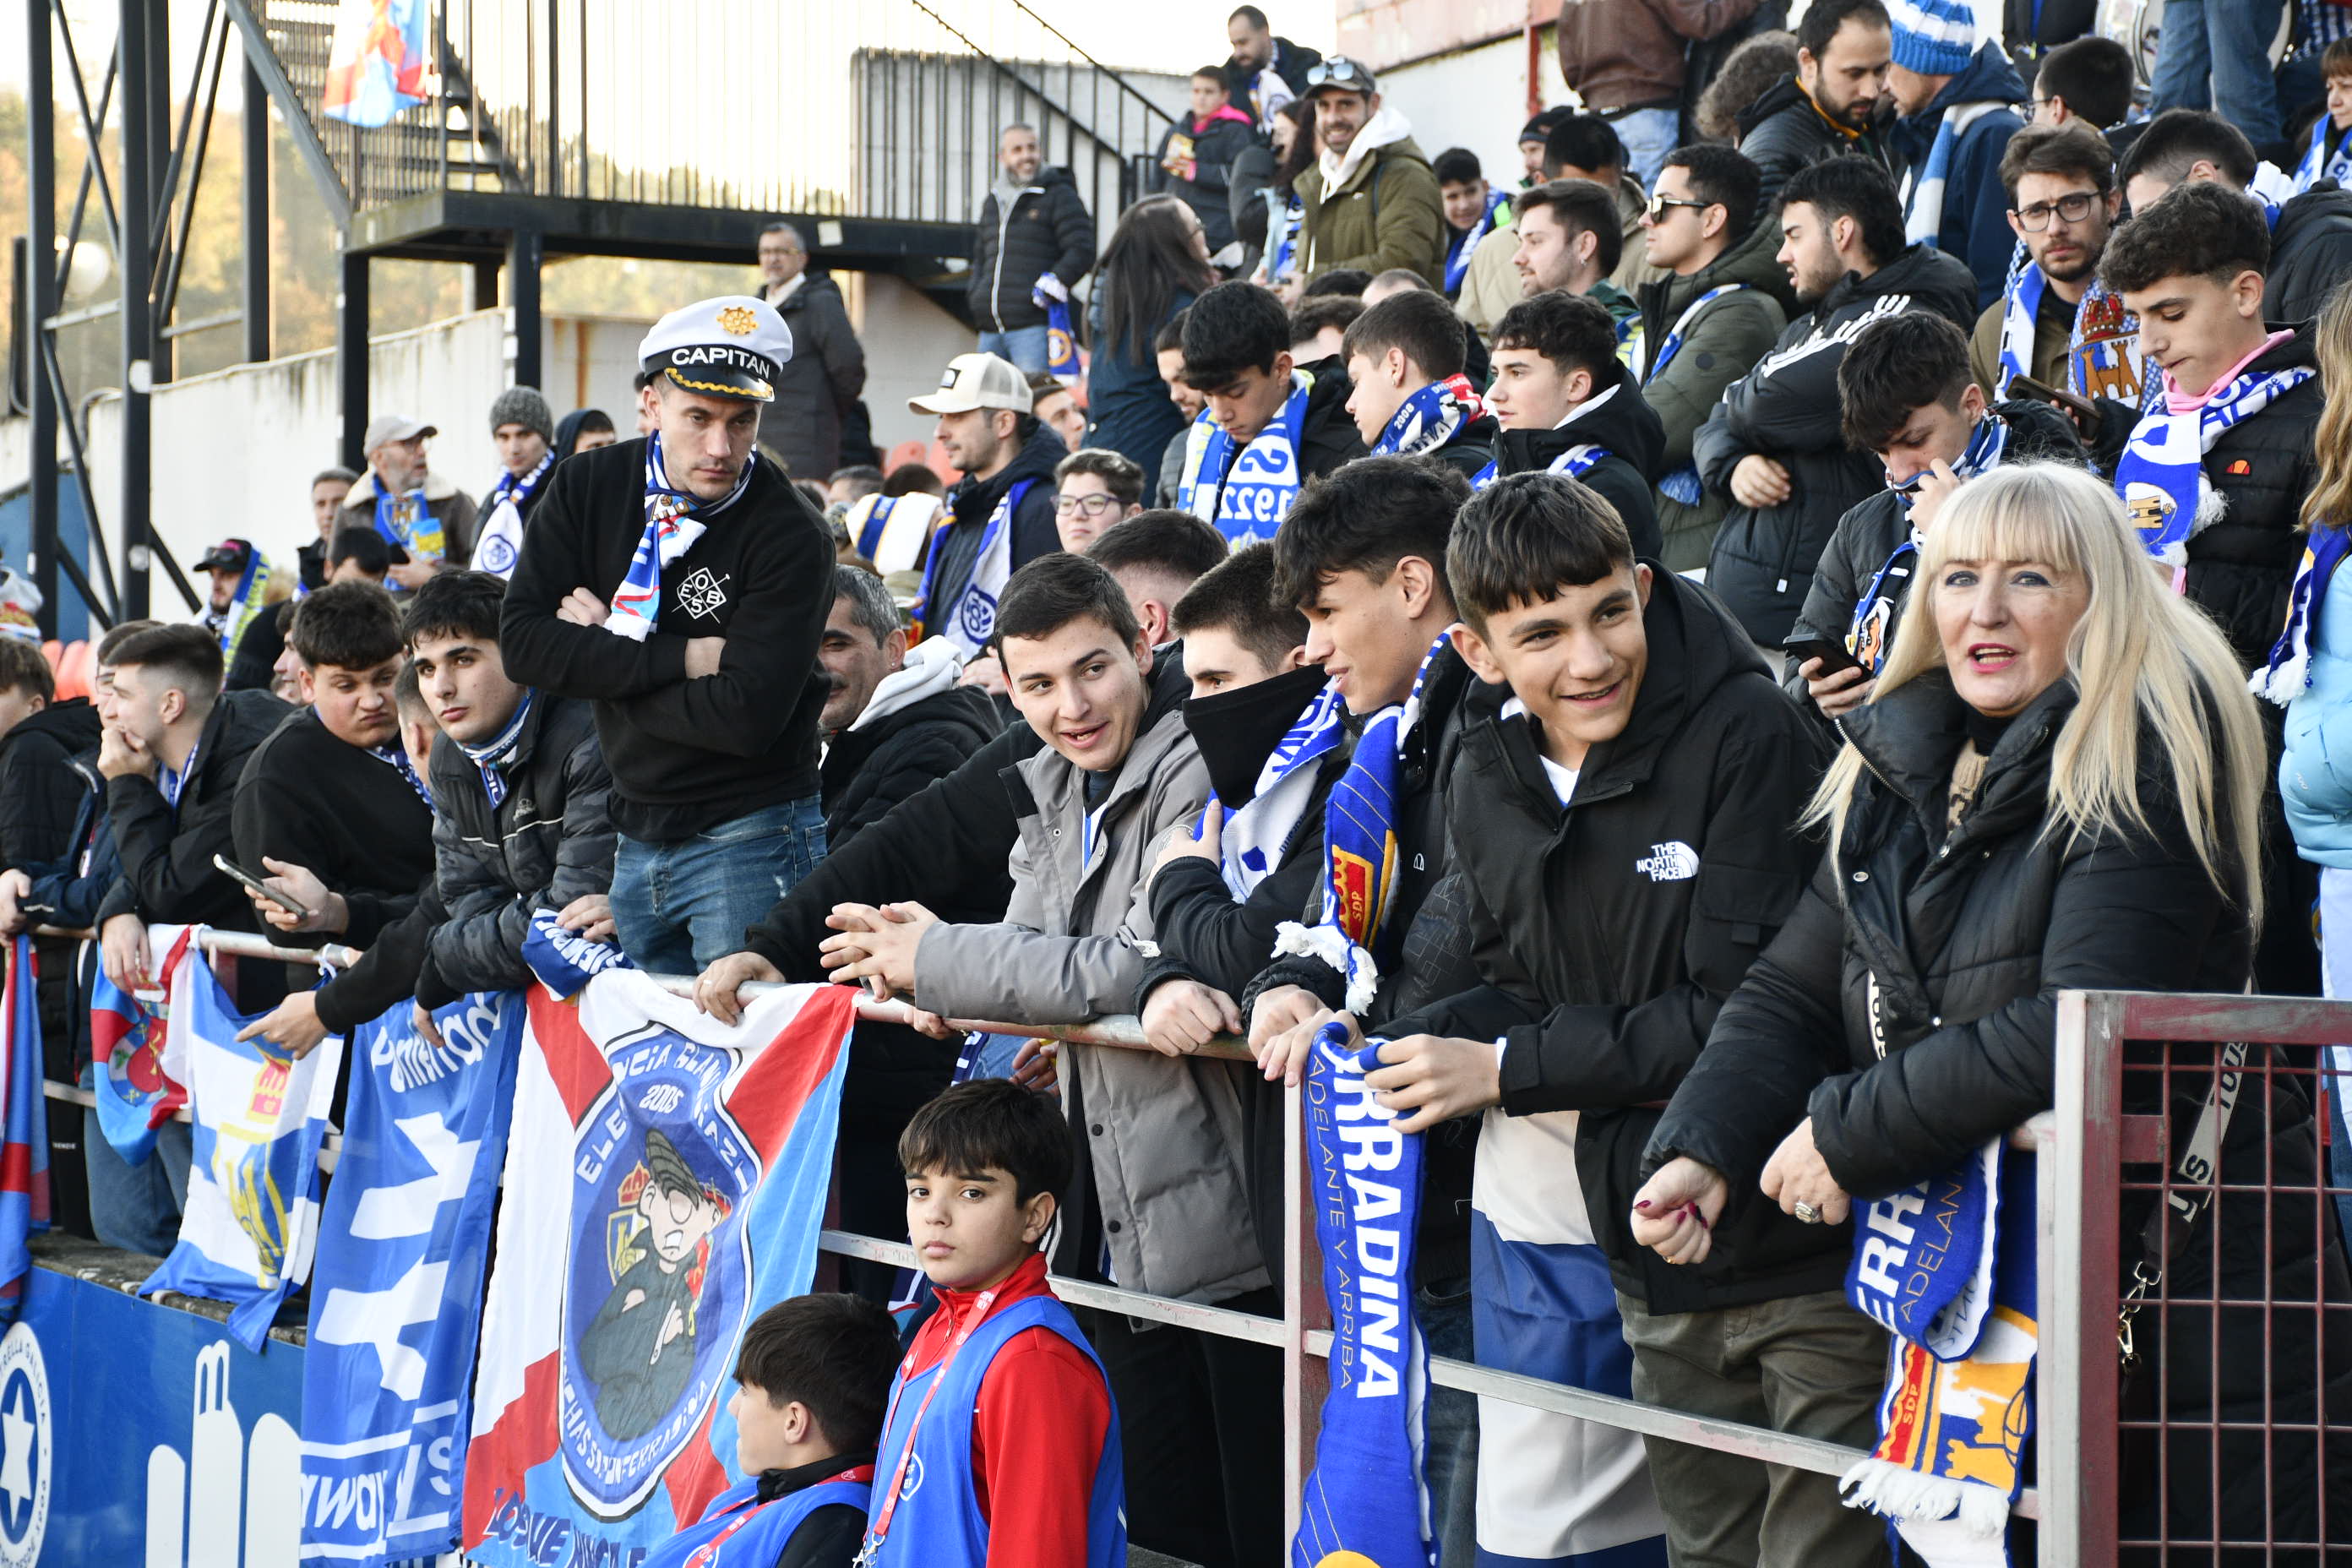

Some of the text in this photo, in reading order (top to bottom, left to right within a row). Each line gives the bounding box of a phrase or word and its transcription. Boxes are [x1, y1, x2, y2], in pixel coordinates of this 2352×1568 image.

[672, 347, 770, 379] CAPITAN
[1636, 854, 1678, 873] NORTH
[1651, 841, 1676, 857] THE
[1651, 866, 1679, 882] FACE
[1352, 890, 1364, 922] SDP
[639, 1083, 684, 1114] 2005
[1309, 1054, 1353, 1390] ADELANTE Y ARRIBA
[1903, 1383, 1919, 1426] SDP
